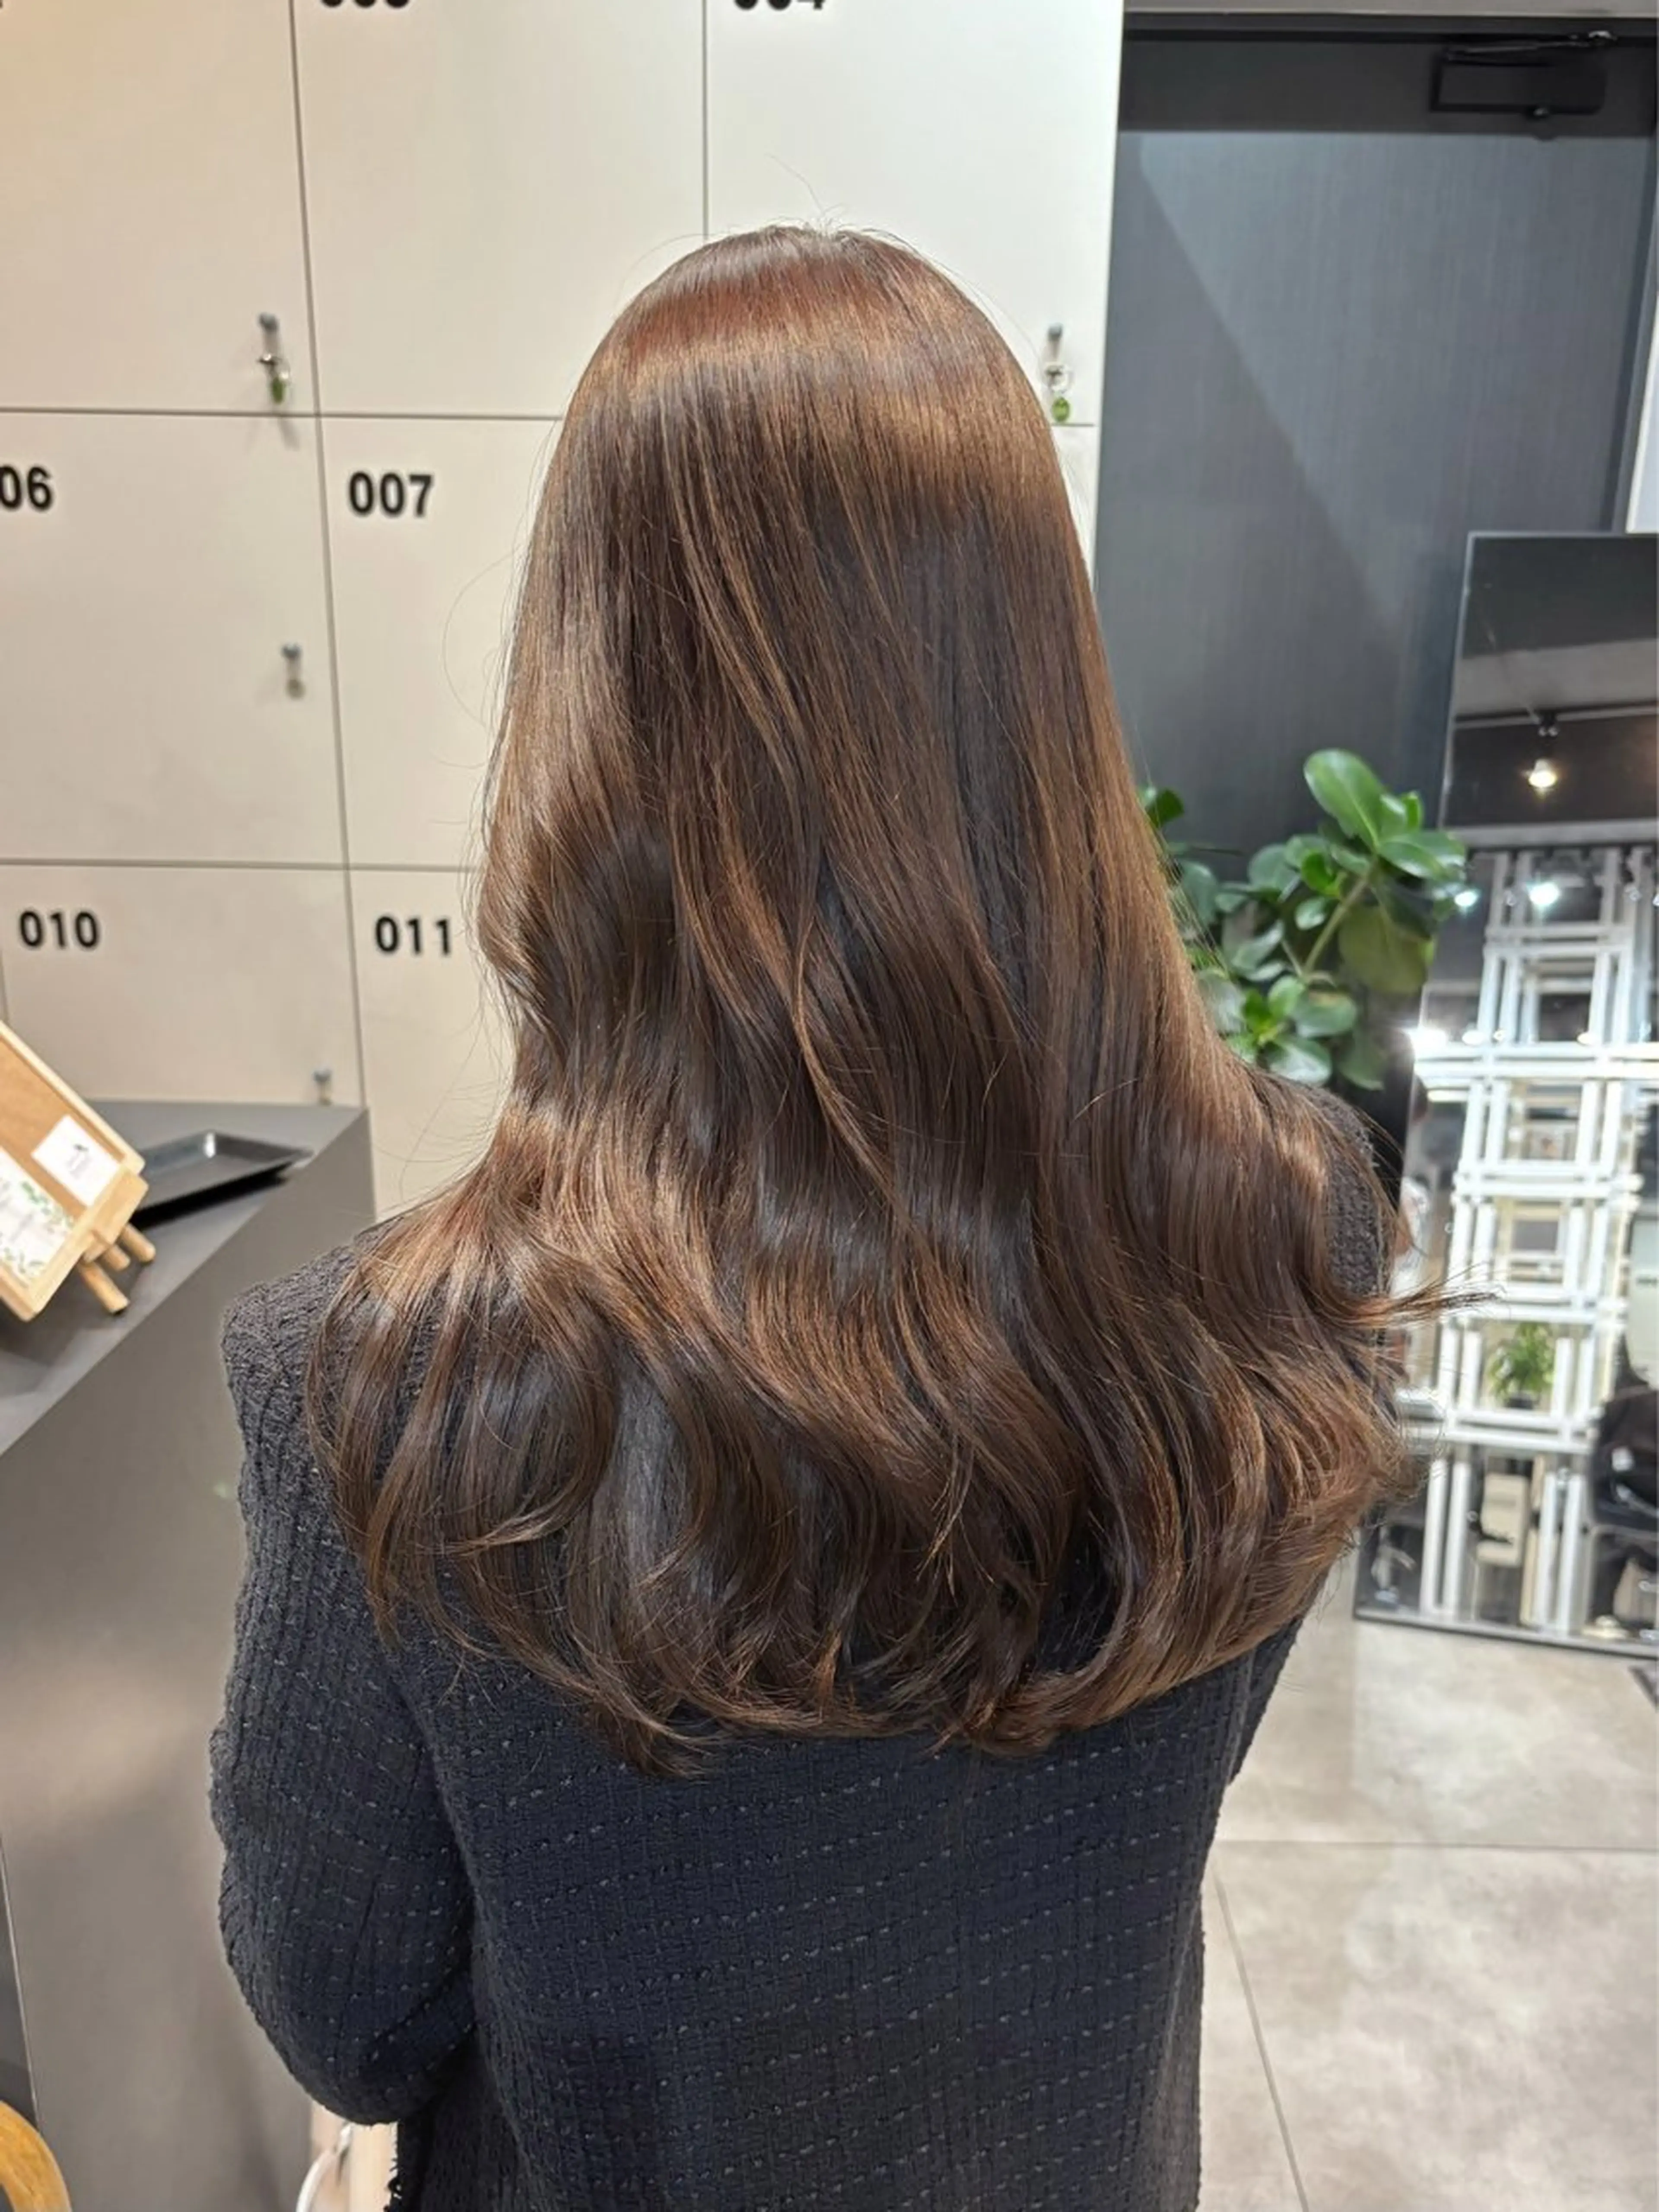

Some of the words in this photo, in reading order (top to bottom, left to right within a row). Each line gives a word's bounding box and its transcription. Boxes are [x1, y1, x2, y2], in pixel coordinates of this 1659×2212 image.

[349, 471, 432, 516] 007
[19, 910, 100, 950] 010
[375, 916, 450, 955] 011
